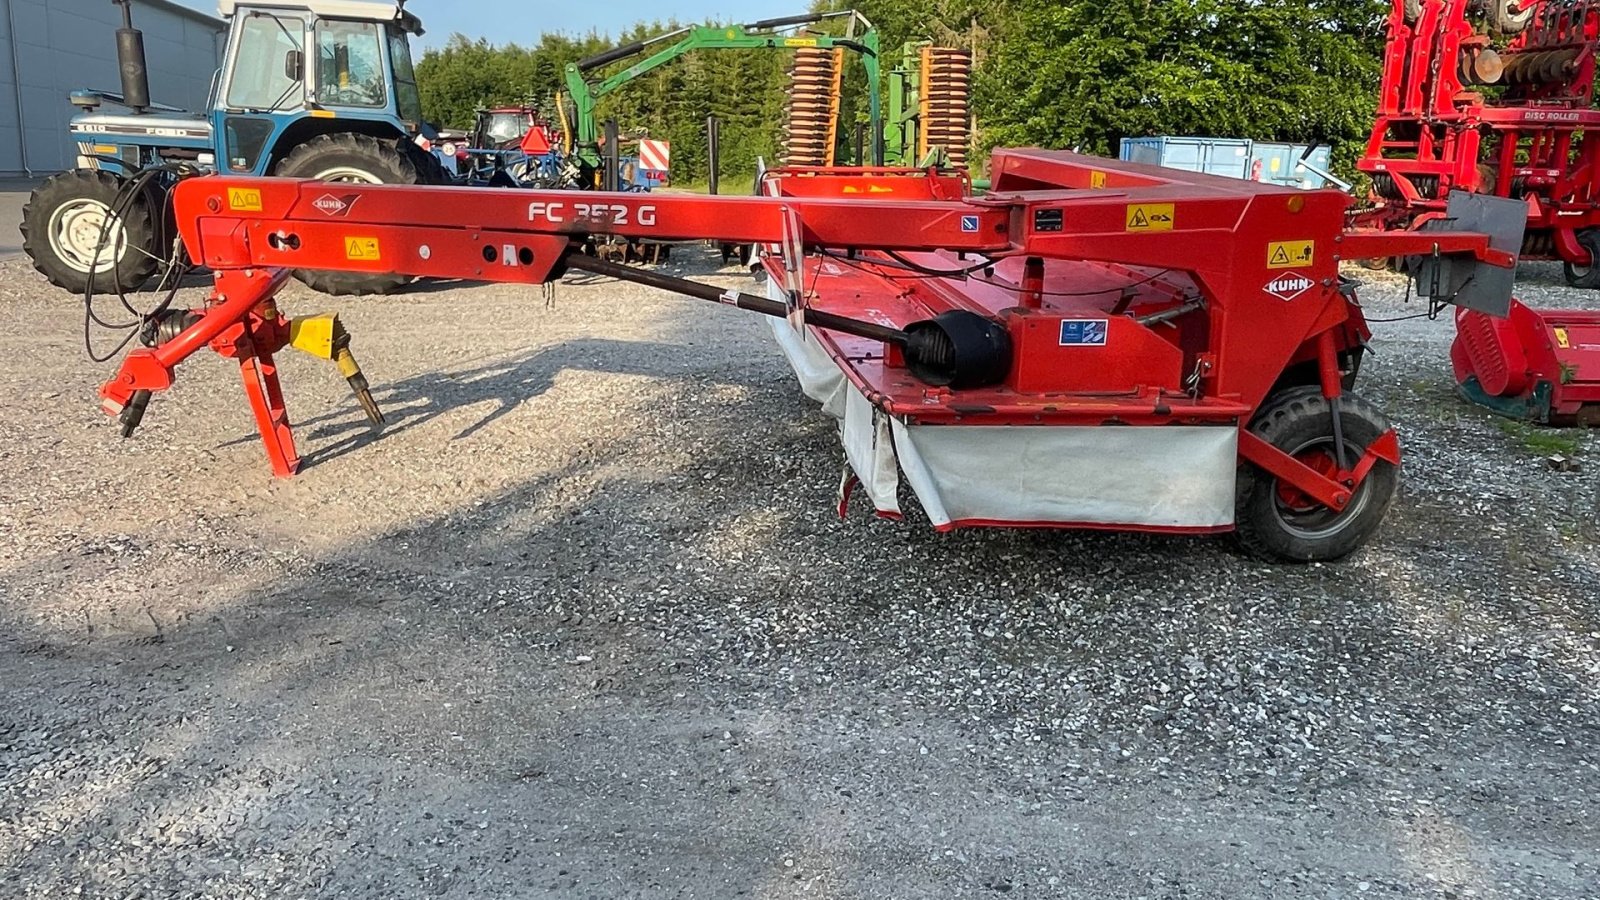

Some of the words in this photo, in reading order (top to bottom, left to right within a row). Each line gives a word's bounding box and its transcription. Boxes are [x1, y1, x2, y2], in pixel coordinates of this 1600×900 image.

[1524, 112, 1545, 120] DISC
[1547, 112, 1579, 121] ROLLER
[317, 200, 341, 209] KUHN
[528, 202, 563, 222] FC
[637, 205, 656, 226] G
[1268, 278, 1309, 292] KUHN
